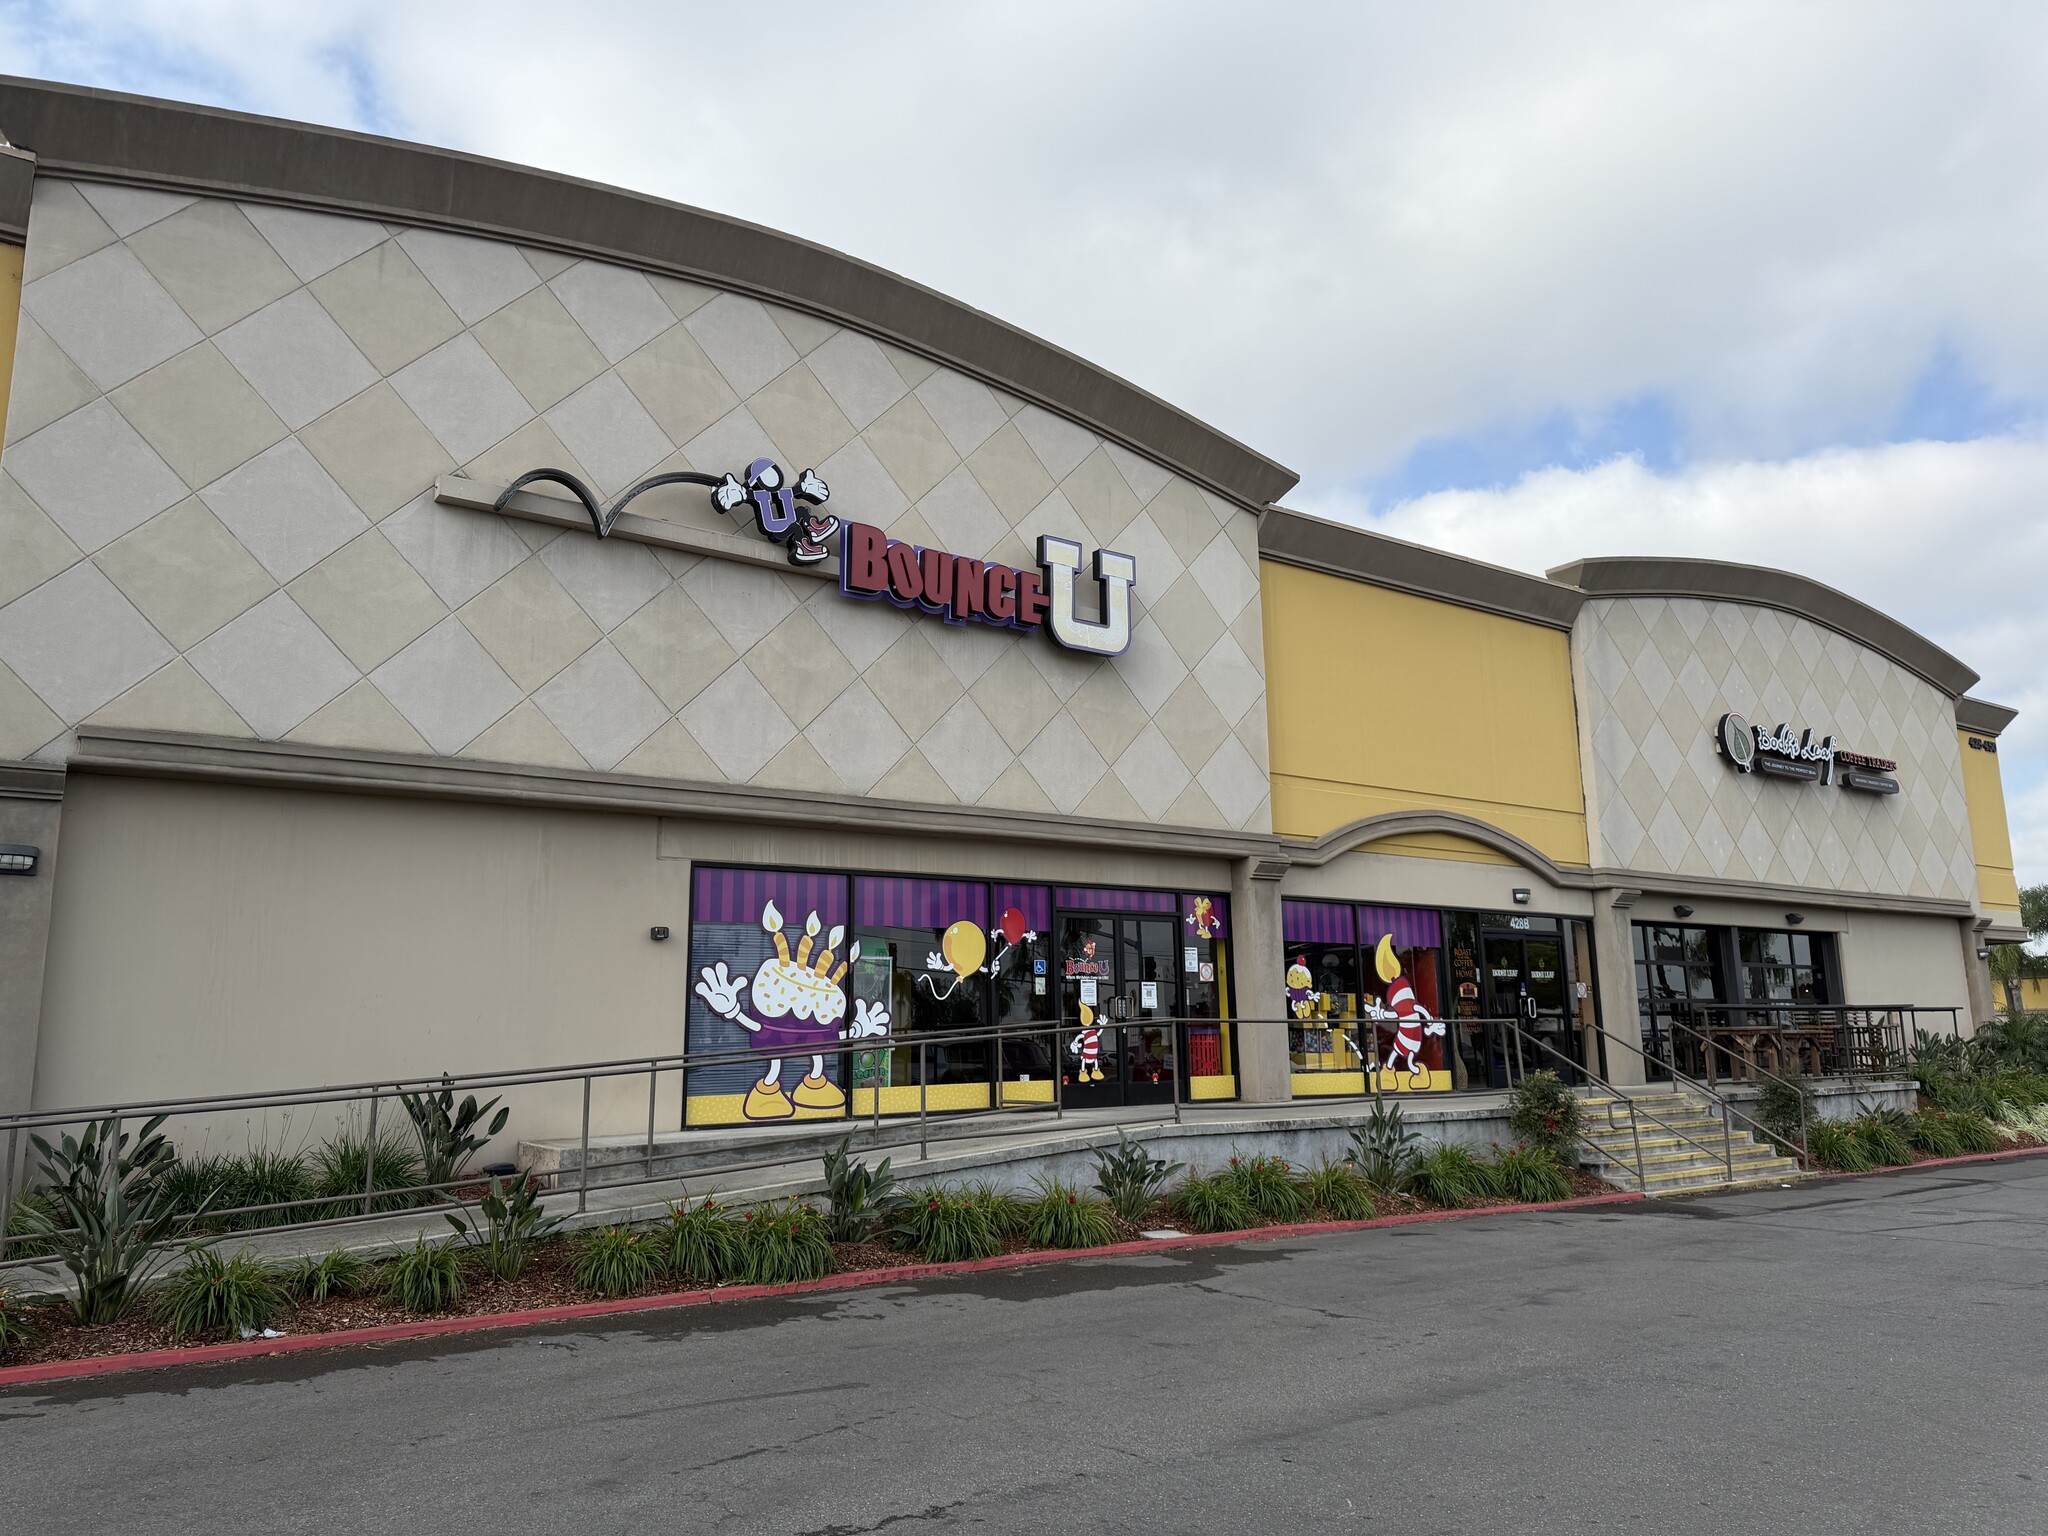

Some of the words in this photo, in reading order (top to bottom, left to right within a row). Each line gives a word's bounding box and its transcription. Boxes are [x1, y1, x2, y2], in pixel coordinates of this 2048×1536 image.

[1757, 722, 1801, 760] Bodhi
[1801, 728, 1838, 786] Leaf
[1839, 750, 1868, 766] COFFEE
[1453, 948, 1472, 957] ROAST
[1453, 959, 1474, 967] COFFEE
[1455, 970, 1474, 978] HOME
